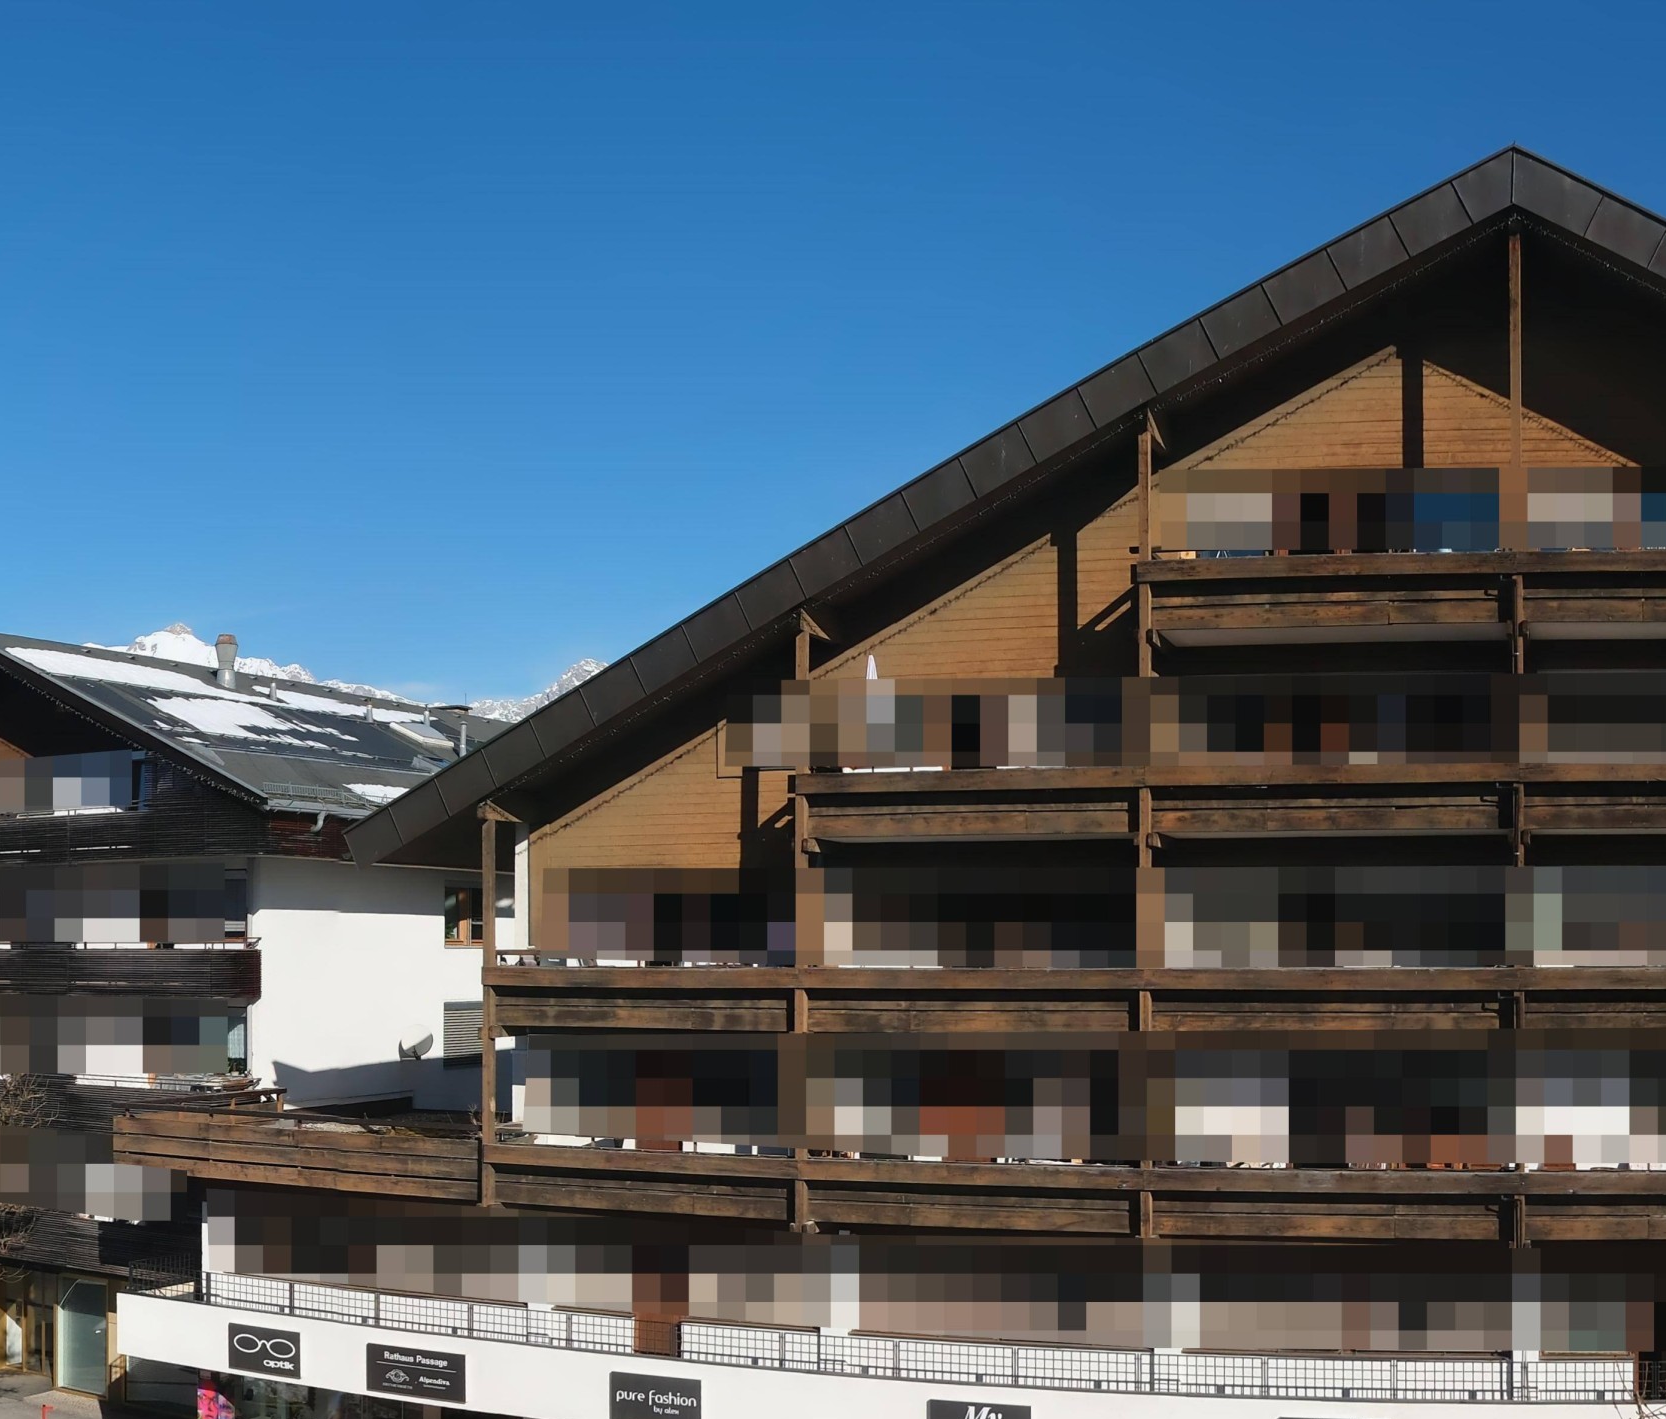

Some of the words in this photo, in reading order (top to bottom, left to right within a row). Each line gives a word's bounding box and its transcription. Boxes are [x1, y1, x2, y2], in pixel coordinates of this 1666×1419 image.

[263, 1358, 295, 1371] optik
[384, 1350, 414, 1363] Rathaus
[416, 1354, 448, 1368] Passage
[419, 1375, 450, 1387] Alpendiva
[616, 1389, 645, 1402] pure
[648, 1389, 697, 1407] fashion
[653, 1405, 663, 1415] by
[664, 1406, 679, 1415] alex
